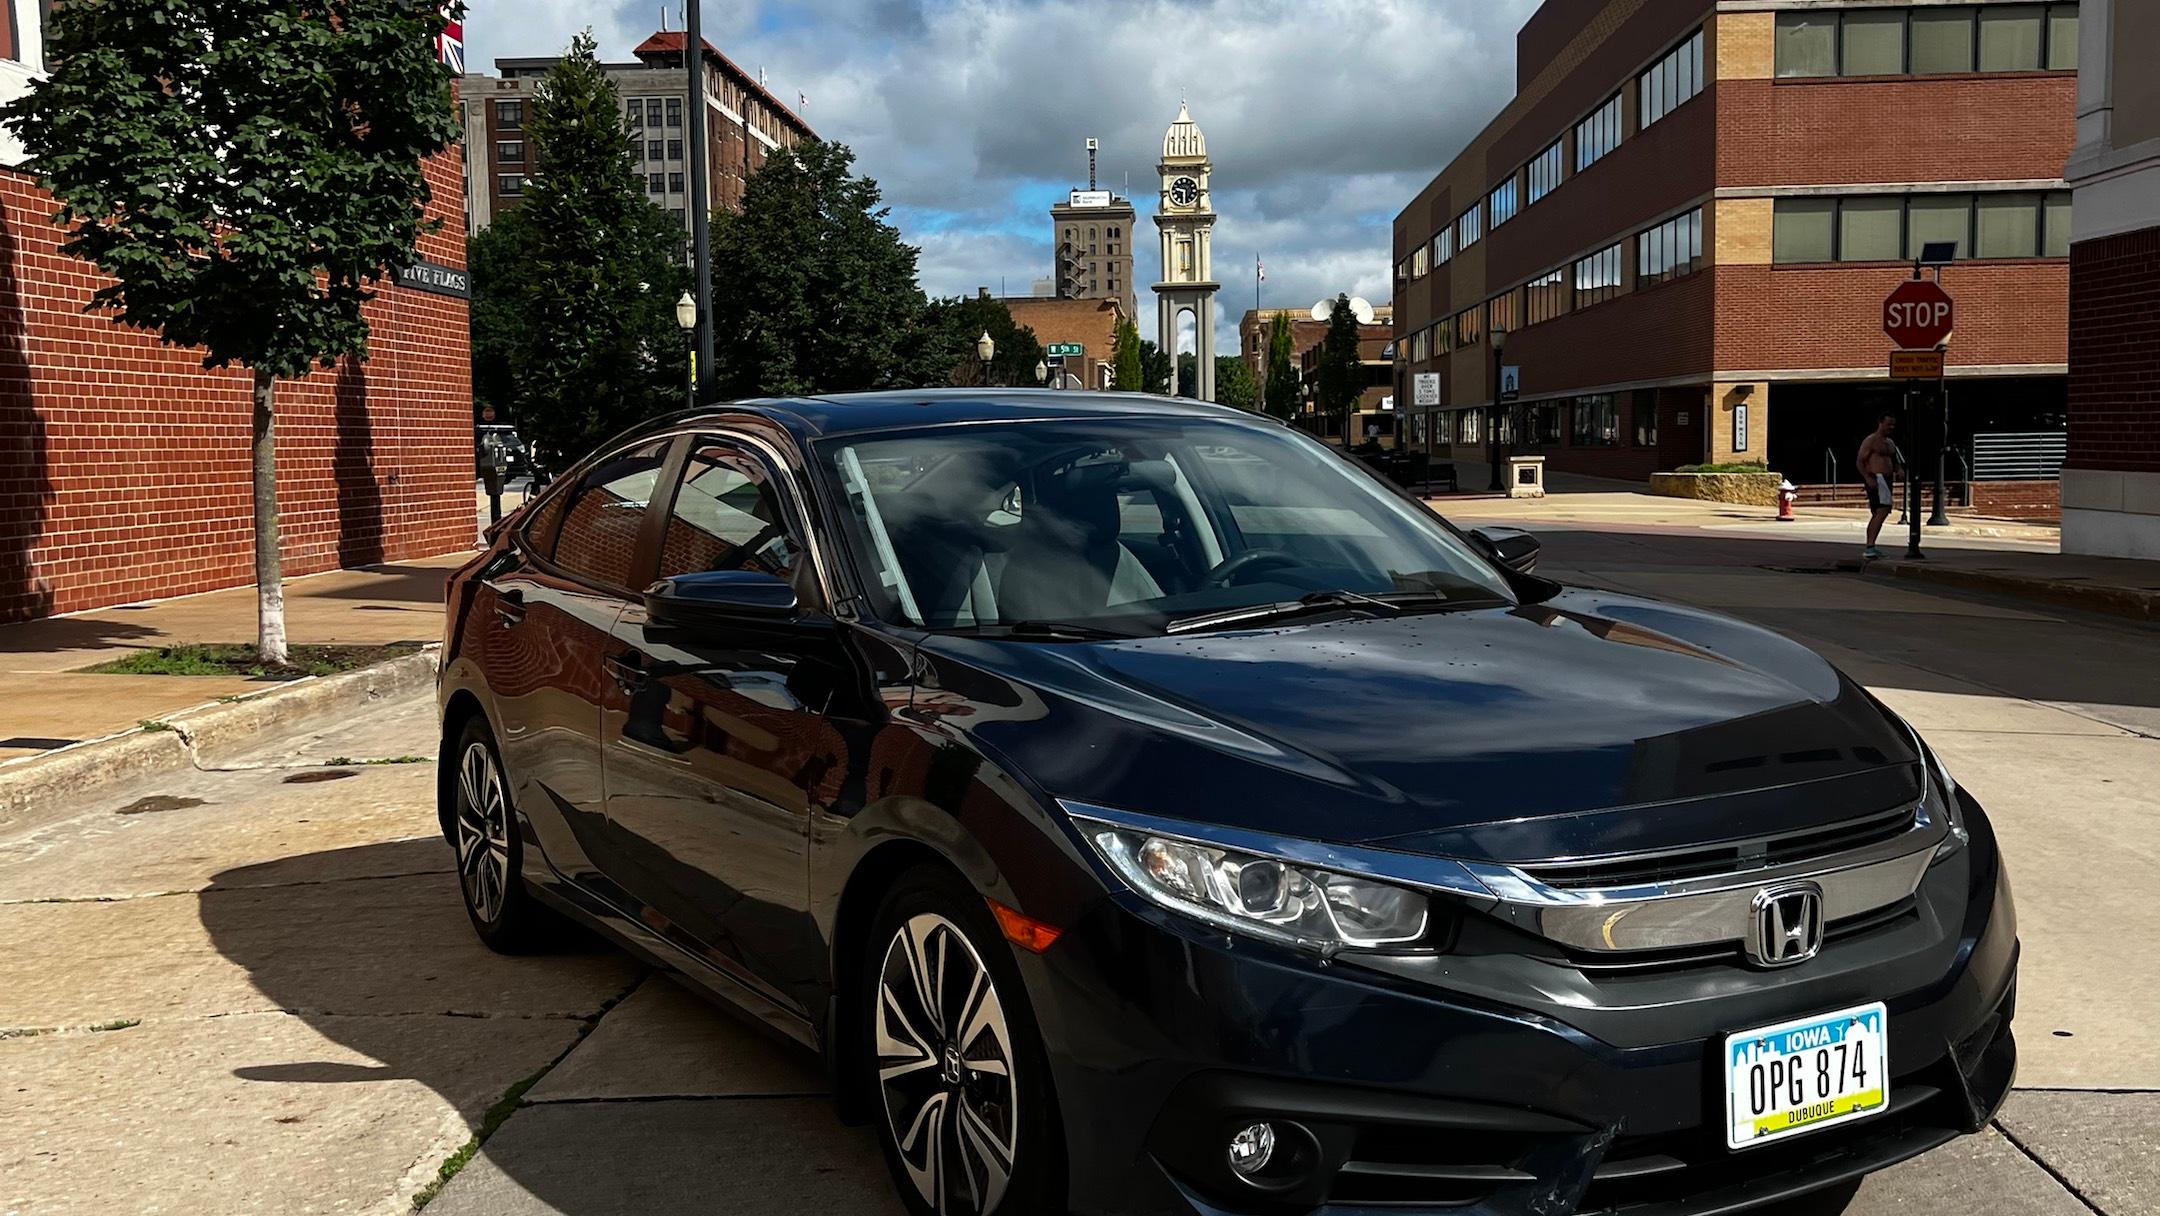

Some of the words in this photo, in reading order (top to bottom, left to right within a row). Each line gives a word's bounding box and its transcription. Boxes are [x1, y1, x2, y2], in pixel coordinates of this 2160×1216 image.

[403, 265, 430, 284] FIVE
[432, 269, 466, 291] FLAGS
[1887, 302, 1950, 328] STOP
[1786, 1025, 1832, 1053] IOWA
[1750, 1055, 1804, 1115] OPG
[1816, 1040, 1867, 1098] 874
[1788, 1100, 1835, 1124] DUBUQUE
